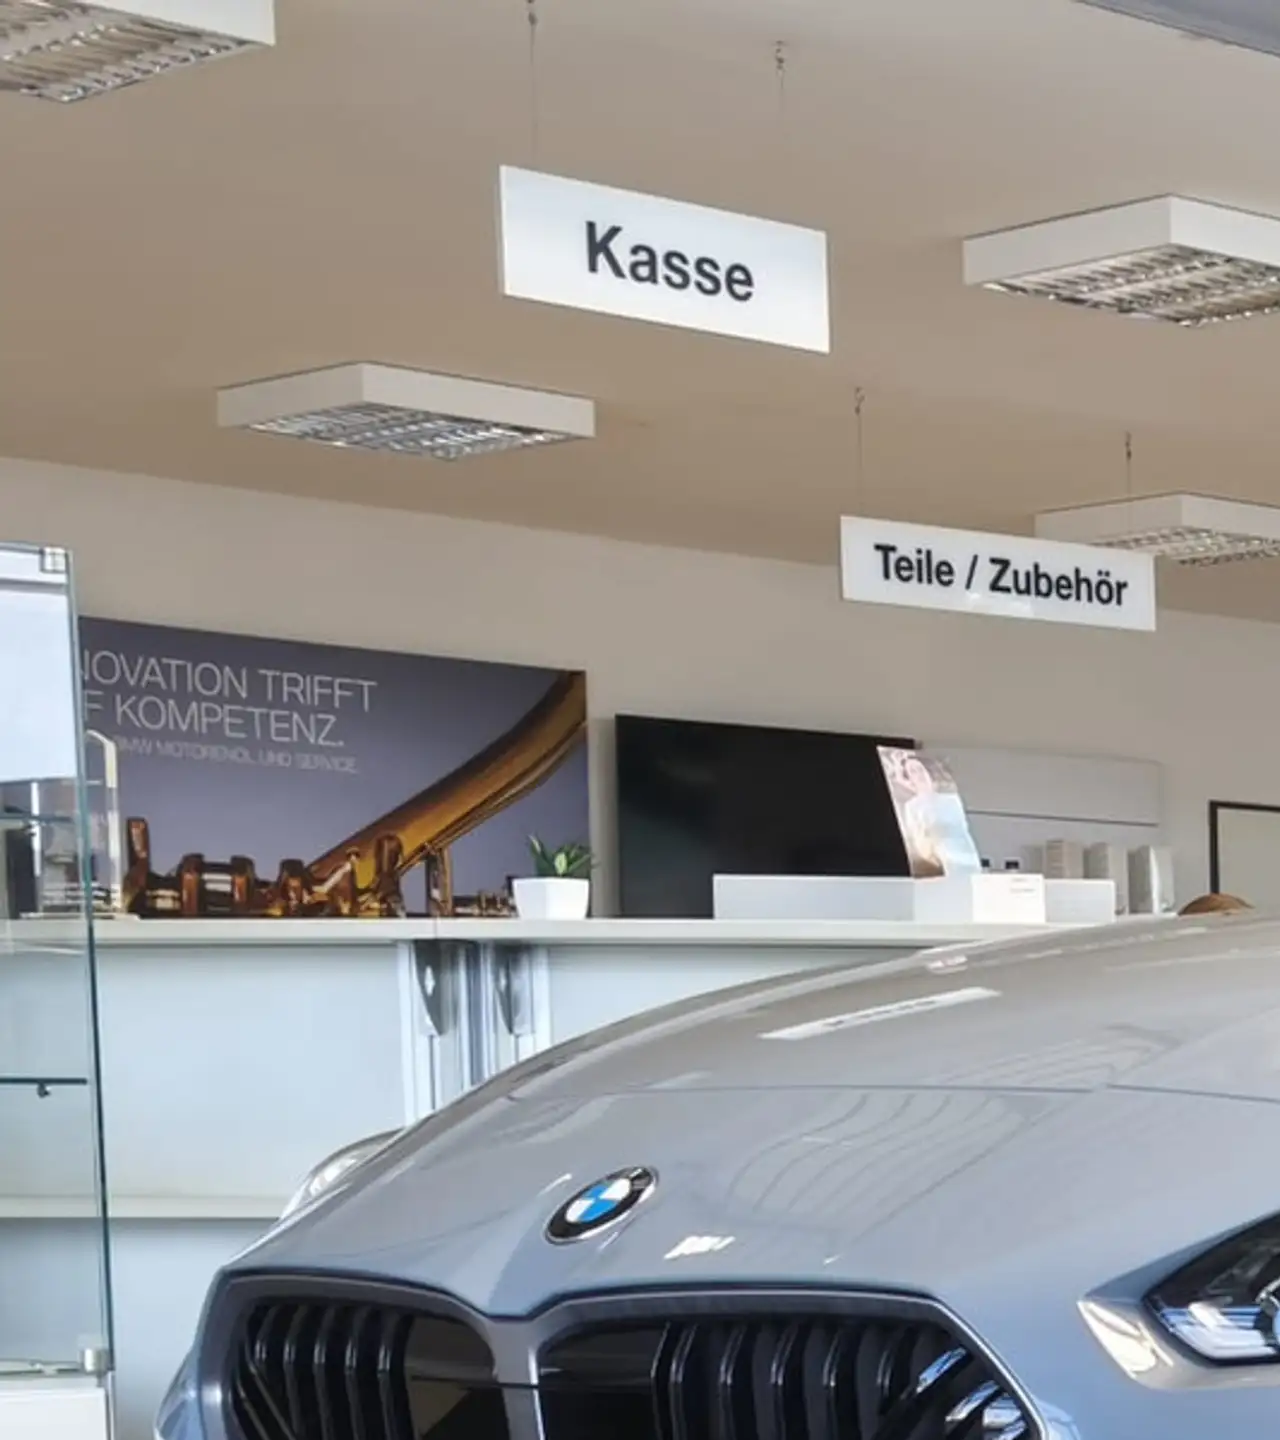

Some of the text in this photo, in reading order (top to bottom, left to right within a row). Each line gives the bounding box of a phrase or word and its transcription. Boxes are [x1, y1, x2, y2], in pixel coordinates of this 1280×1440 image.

[585, 220, 754, 302] Kasse
[874, 543, 1129, 607] Teile / Zubehör
[114, 693, 345, 746] KOMPETENZ.
[257, 668, 378, 713] TRIFFT
